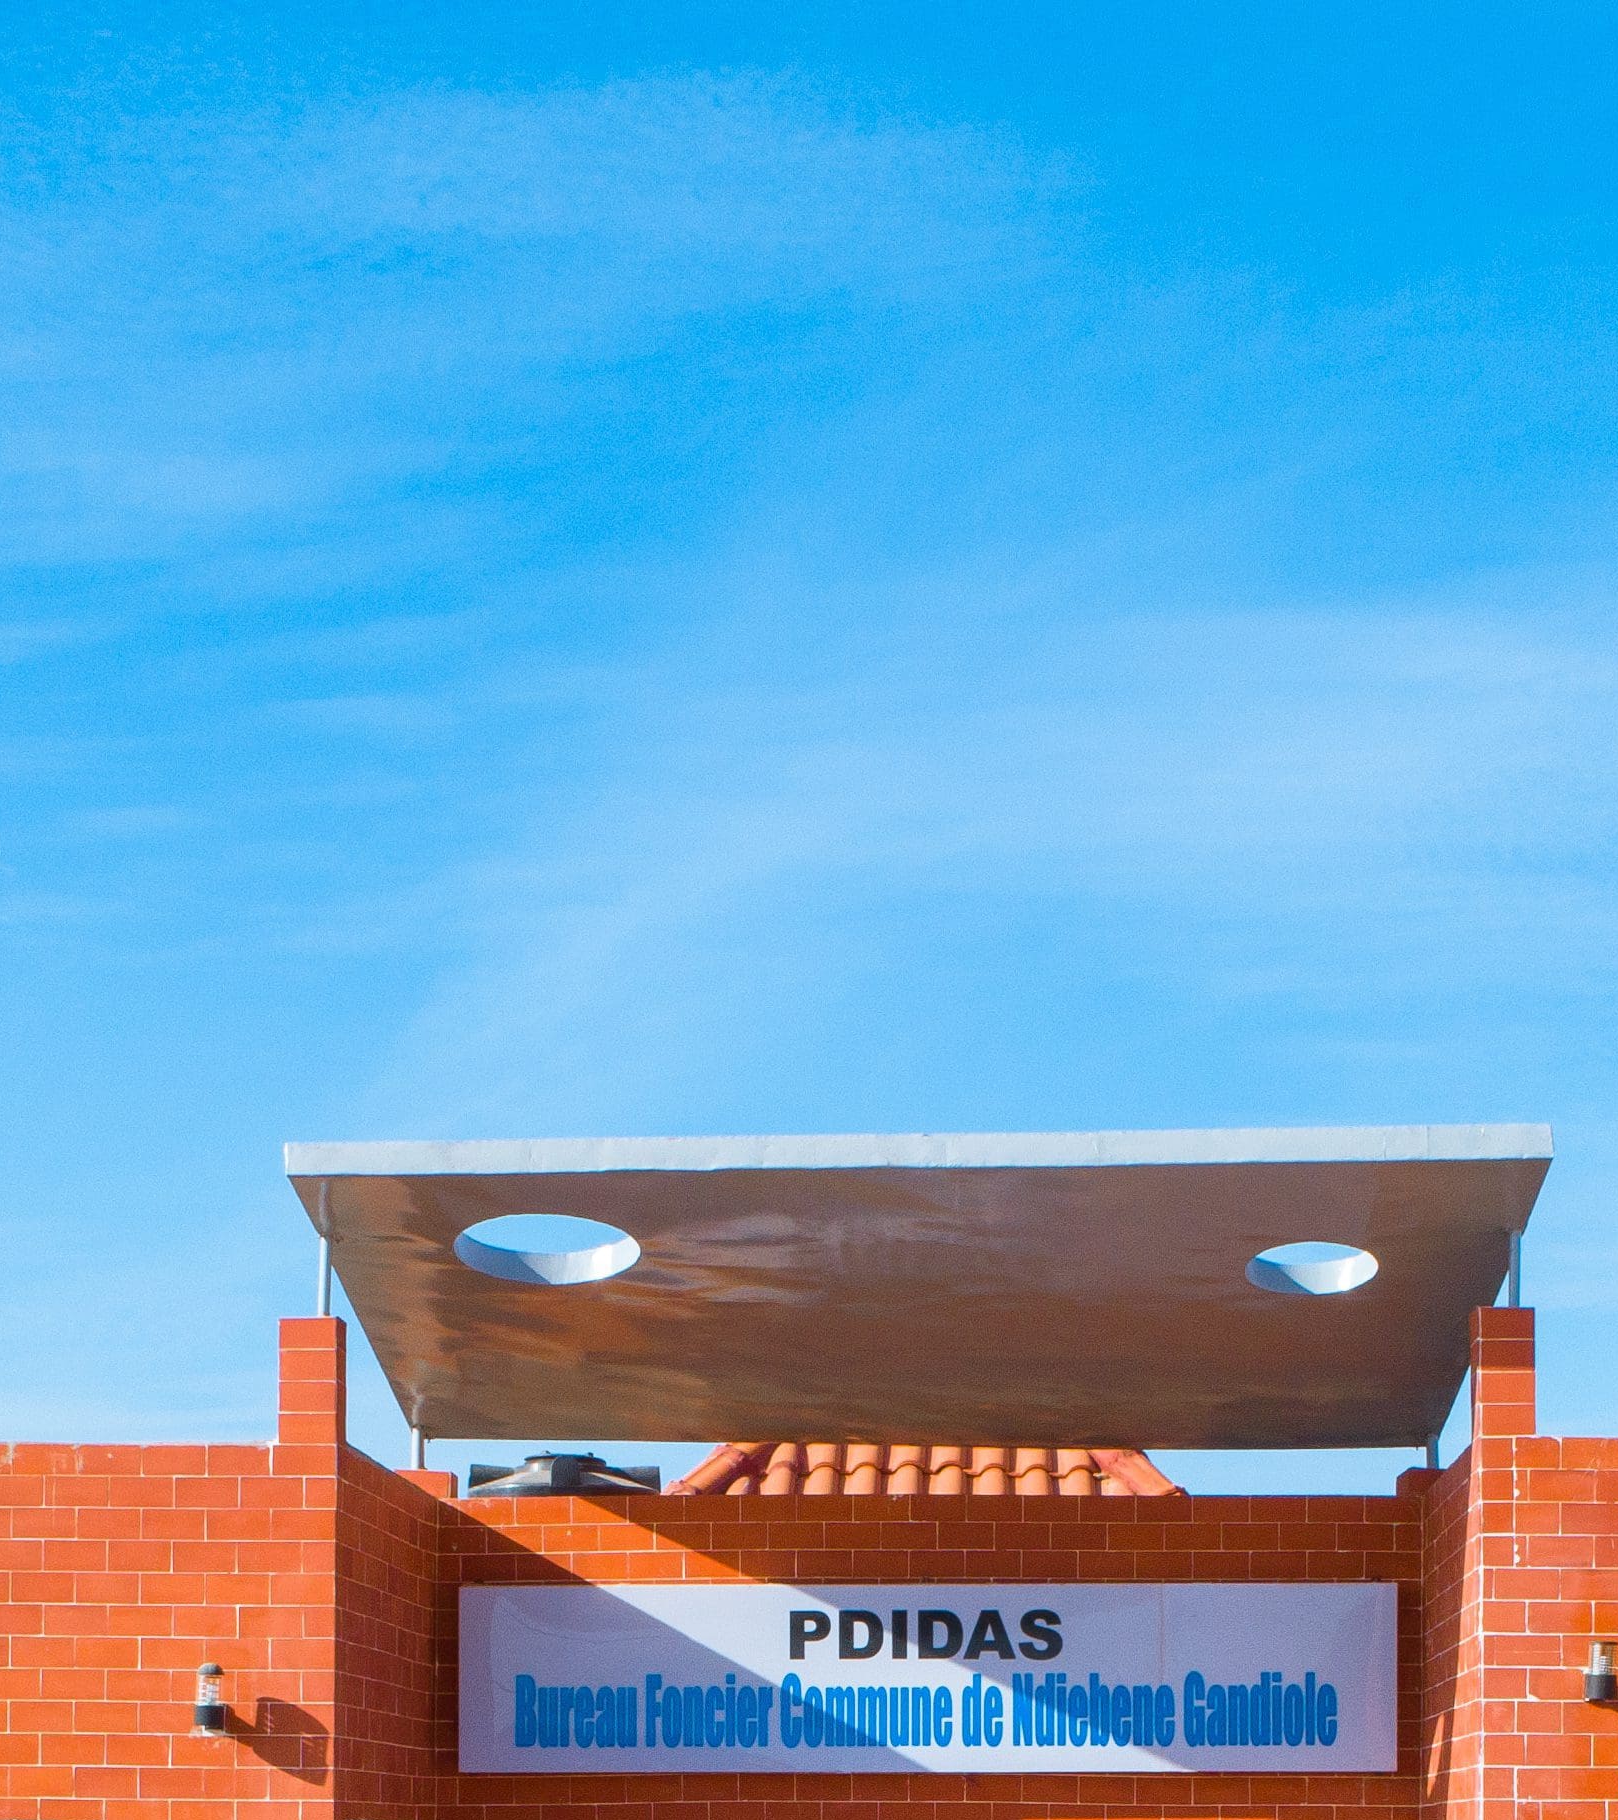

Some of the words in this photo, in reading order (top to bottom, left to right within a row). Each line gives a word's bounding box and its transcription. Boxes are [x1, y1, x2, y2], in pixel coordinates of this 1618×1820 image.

[790, 1609, 1063, 1660] PDIDAS
[515, 1674, 637, 1748] Bureau
[645, 1673, 773, 1748] Foncier
[780, 1673, 953, 1748] Commune
[962, 1673, 1003, 1747] de
[1012, 1672, 1176, 1747] Ndiebene
[1183, 1670, 1338, 1747] Gandiole
